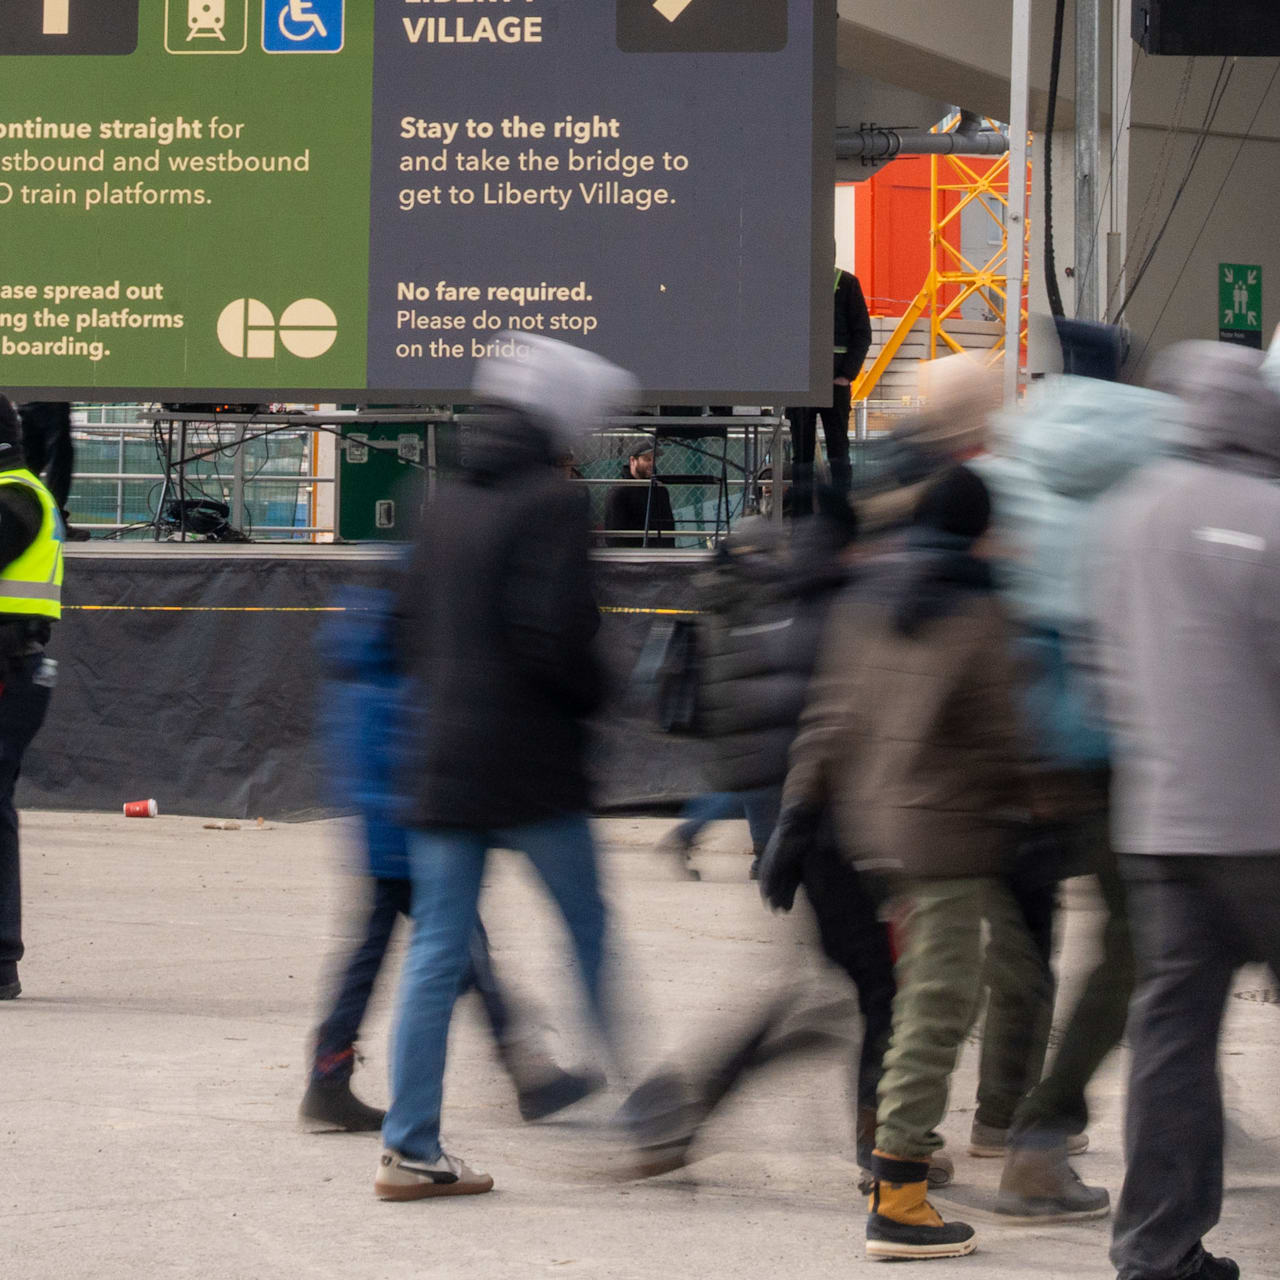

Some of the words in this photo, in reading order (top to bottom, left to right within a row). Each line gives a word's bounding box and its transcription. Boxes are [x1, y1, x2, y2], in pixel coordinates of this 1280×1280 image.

[402, 17, 542, 43] VILLAGE
[99, 116, 202, 146] straight
[209, 116, 245, 140] for
[400, 117, 458, 145] Stay
[465, 119, 494, 139] to
[501, 116, 546, 139] the
[554, 116, 620, 145] right
[113, 149, 160, 172] and
[168, 149, 310, 172] westbound
[400, 149, 447, 172] and
[456, 149, 510, 172] take
[518, 149, 560, 172] the
[568, 149, 655, 178] bridge
[663, 152, 689, 172] to
[20, 182, 77, 204] train
[85, 182, 212, 211] platforms.
[398, 185, 442, 211] get
[449, 185, 475, 204] to
[484, 182, 573, 211] Liberty
[578, 182, 676, 211] Village.
[43, 280, 120, 306] spread
[126, 283, 163, 300] out
[397, 282, 430, 302] No
[436, 281, 481, 302] fare
[487, 282, 593, 307] required.
[34, 308, 70, 328] the
[76, 308, 184, 333] platforms
[396, 310, 466, 330] Please
[472, 310, 502, 330] do
[508, 312, 544, 331] not
[549, 312, 598, 335] stop
[2, 335, 111, 361] boarding.
[396, 344, 423, 359] on
[429, 338, 465, 359] the
[471, 338, 535, 364] bridg
